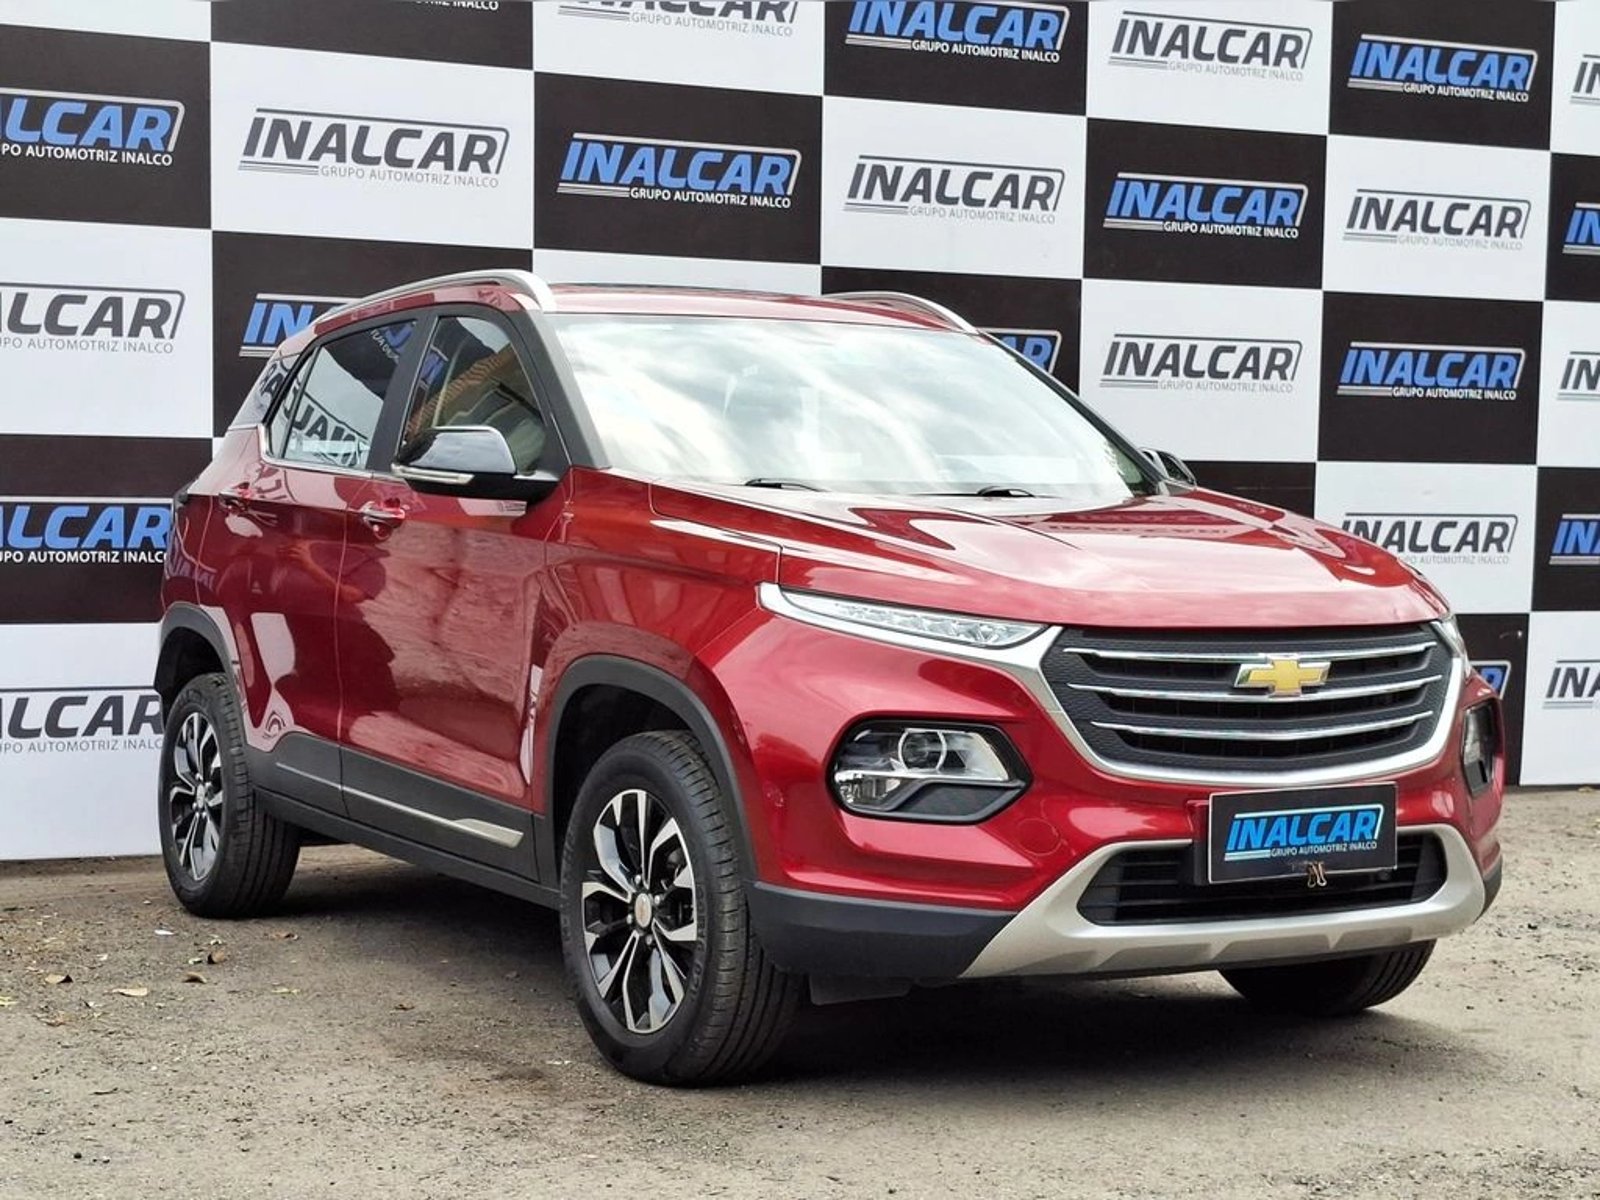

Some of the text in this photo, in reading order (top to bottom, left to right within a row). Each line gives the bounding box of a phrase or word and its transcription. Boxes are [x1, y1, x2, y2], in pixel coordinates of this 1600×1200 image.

[632, 12, 793, 37] GRUPO AUTOMOTRIZ INALCO
[848, 1, 1060, 49] INALCAR
[912, 40, 1060, 63] GRUPO AUTOMOTRIZ INALCO
[1112, 18, 1303, 69] INALCAR
[1169, 61, 1303, 81] GRUPO AUTOMOTRIZ INALCO
[1350, 41, 1529, 90] INALCAR
[1404, 83, 1529, 102] GRUPO AUTOMOTRIZ INALCO
[25, 145, 118, 163] AUTOMOTRIZ
[122, 152, 173, 166] INALCO
[242, 116, 498, 175] INALCAR
[320, 165, 499, 189] GRUPO AUTOMOTRIZ INALCO
[560, 141, 791, 195] INALCAR
[630, 187, 791, 209] GRUPO AUTOMOTRIZ INALCO
[847, 163, 1055, 212] INALCAR
[910, 205, 1055, 224] GRUPO AUTOMOTRIZ INALCO
[1106, 180, 1300, 226] INALCAR
[1346, 196, 1523, 239] INALCAR
[1164, 221, 1299, 239] GRUPO AUTOMOTRIZ INALCO
[0, 292, 172, 339] LCAR
[0, 337, 174, 354] PO AUTOMOTRIZ INALCO
[1103, 341, 1294, 381] INALCAR
[1340, 349, 1517, 388] INALCAR
[1160, 379, 1293, 393] GRUPO AUTOMOTRIZ INALCO
[1392, 386, 1517, 400] GRUPO AUTOMOTRIZ INALCO
[0, 505, 171, 549] LCAR
[1552, 521, 1600, 554] IN
[27, 551, 120, 563] AUTOMOTRIZ
[0, 695, 164, 739] LCAR
[28, 739, 120, 753] AUTOMOTRIZ
[123, 738, 164, 750] INALC
[1227, 811, 1377, 850] INALCAR
[1271, 841, 1377, 857] GRUPO AUTOMOTRIZ INALCO
